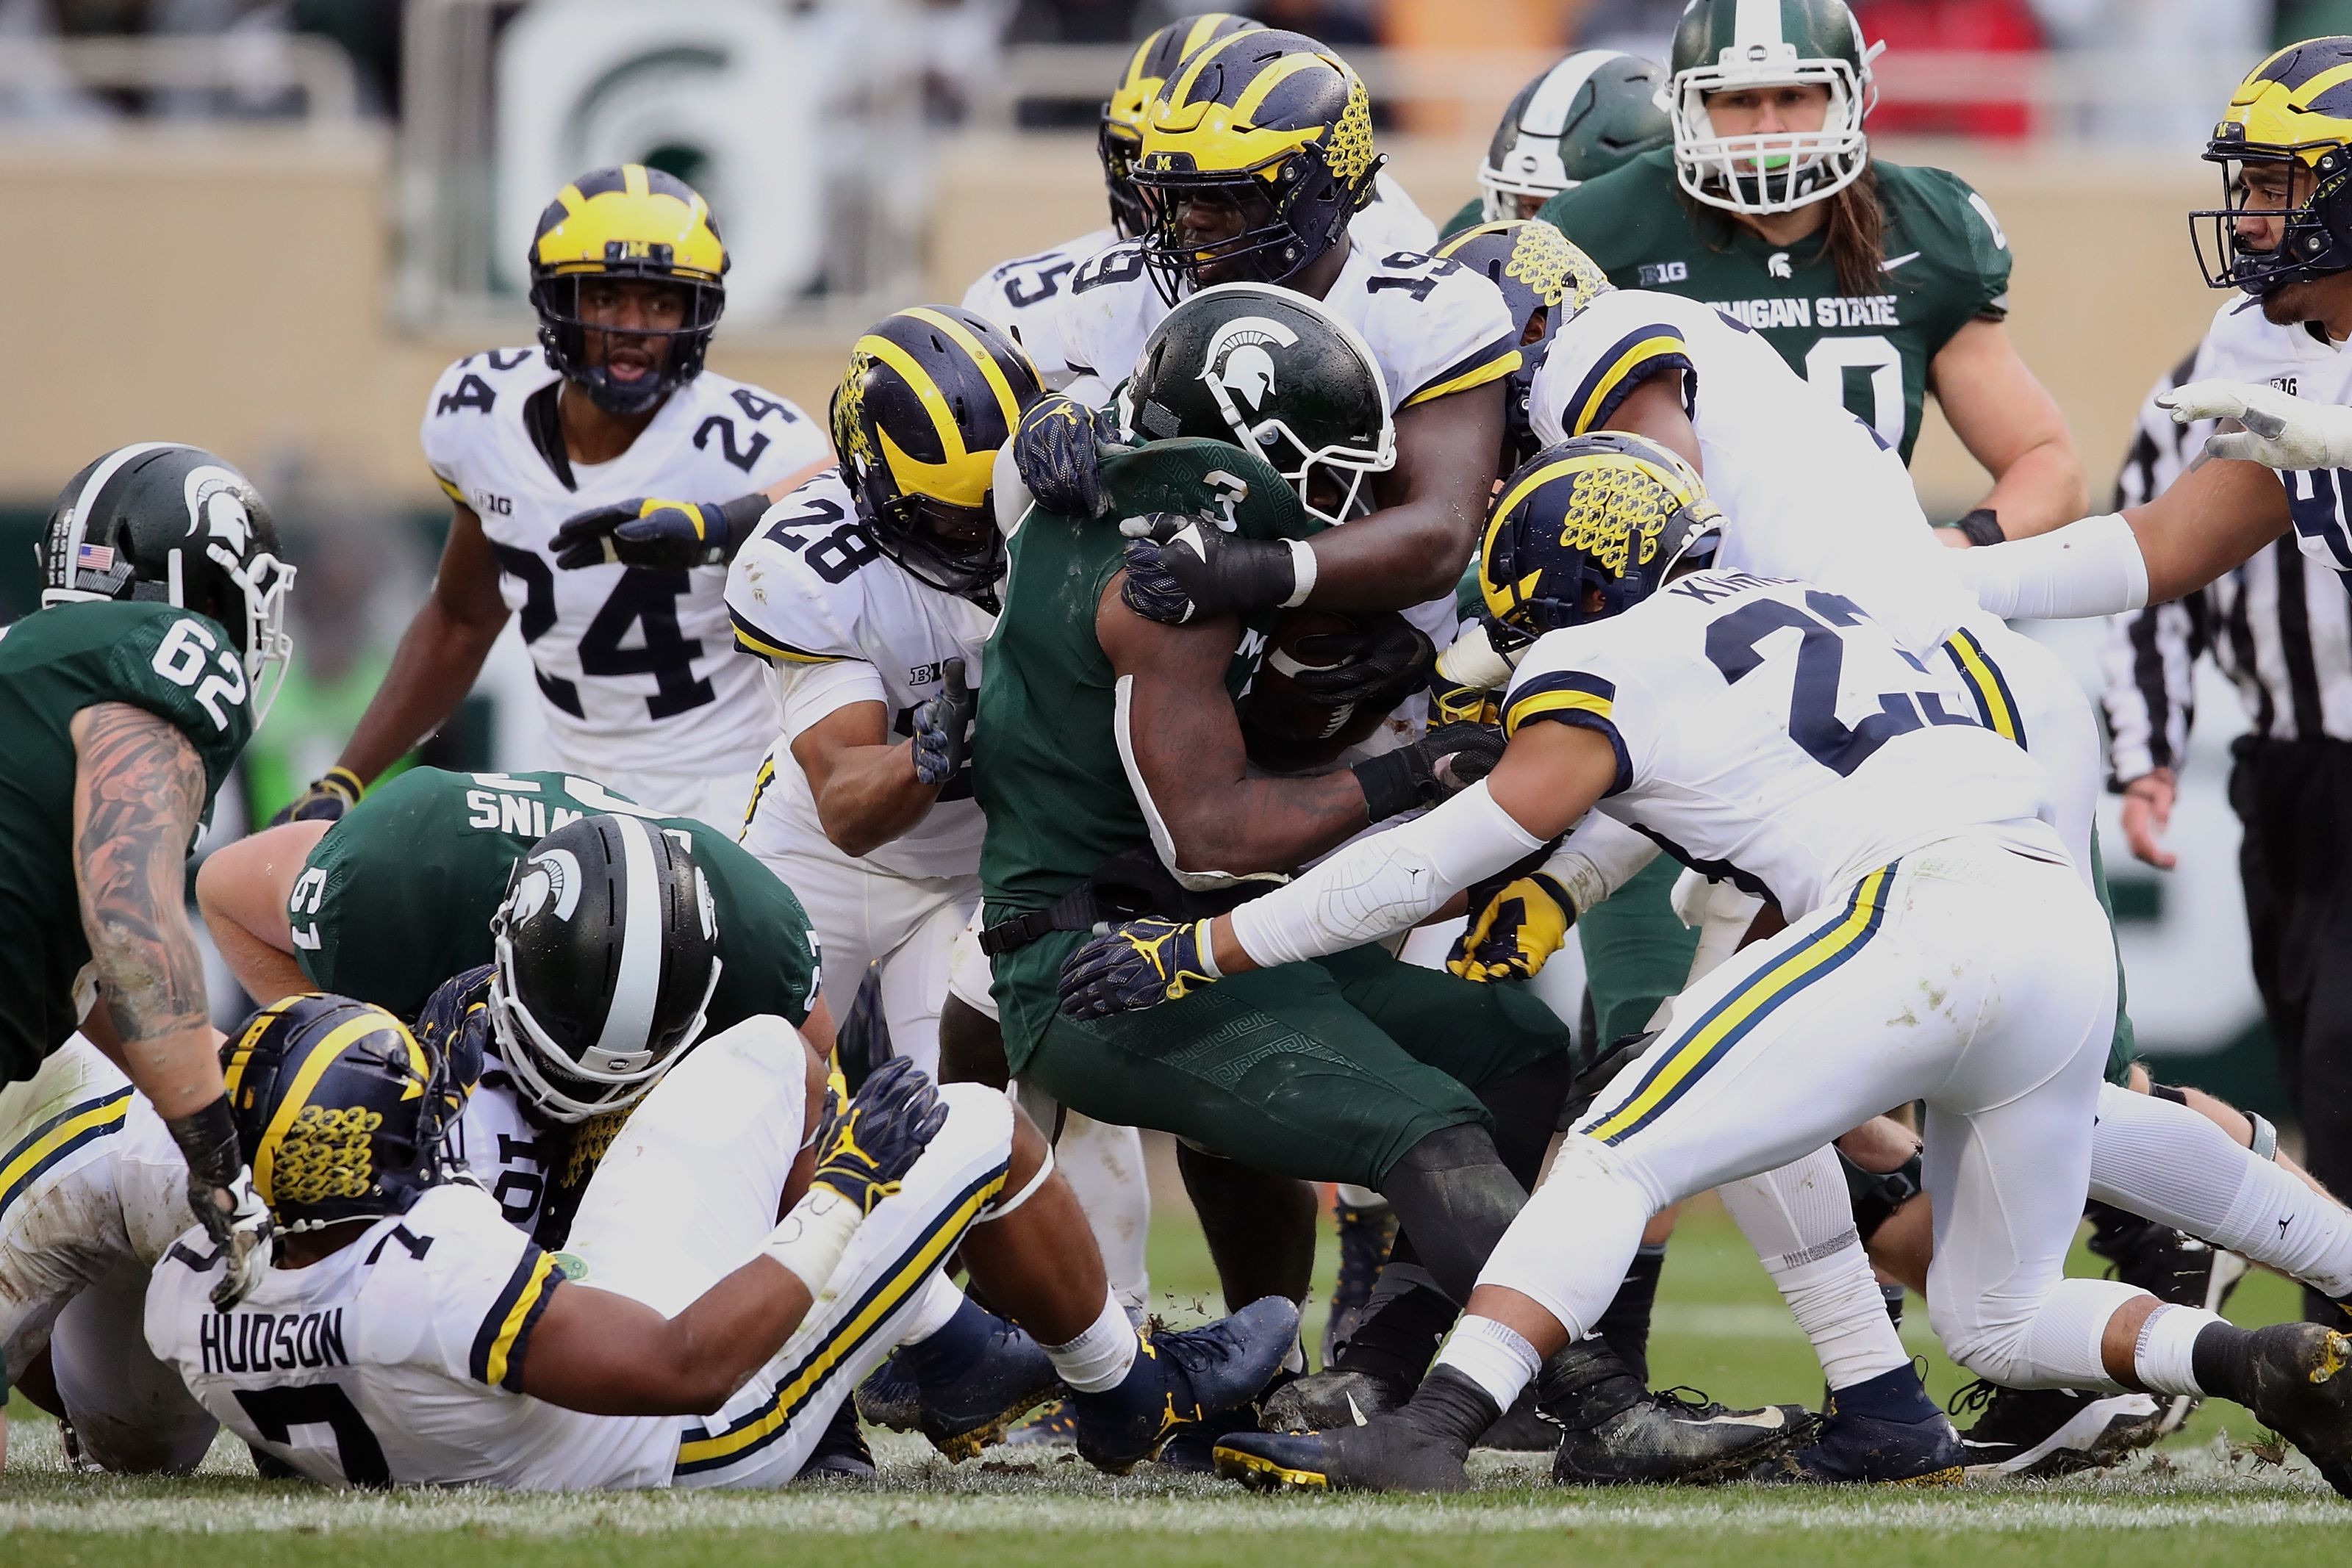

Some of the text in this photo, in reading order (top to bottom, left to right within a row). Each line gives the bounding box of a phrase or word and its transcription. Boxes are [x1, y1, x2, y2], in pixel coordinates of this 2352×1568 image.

[1156, 155, 1172, 170] M
[628, 241, 650, 258] M
[1366, 251, 1463, 303] 19
[1815, 295, 1900, 328] STATE
[693, 389, 799, 475] 24
[1200, 470, 1249, 533] 3
[762, 498, 881, 585] 28
[489, 537, 717, 722] 24
[151, 618, 247, 732] 62
[363, 1223, 434, 1266] 7
[200, 1307, 349, 1374] HUDSON
[232, 1382, 395, 1493] 7
